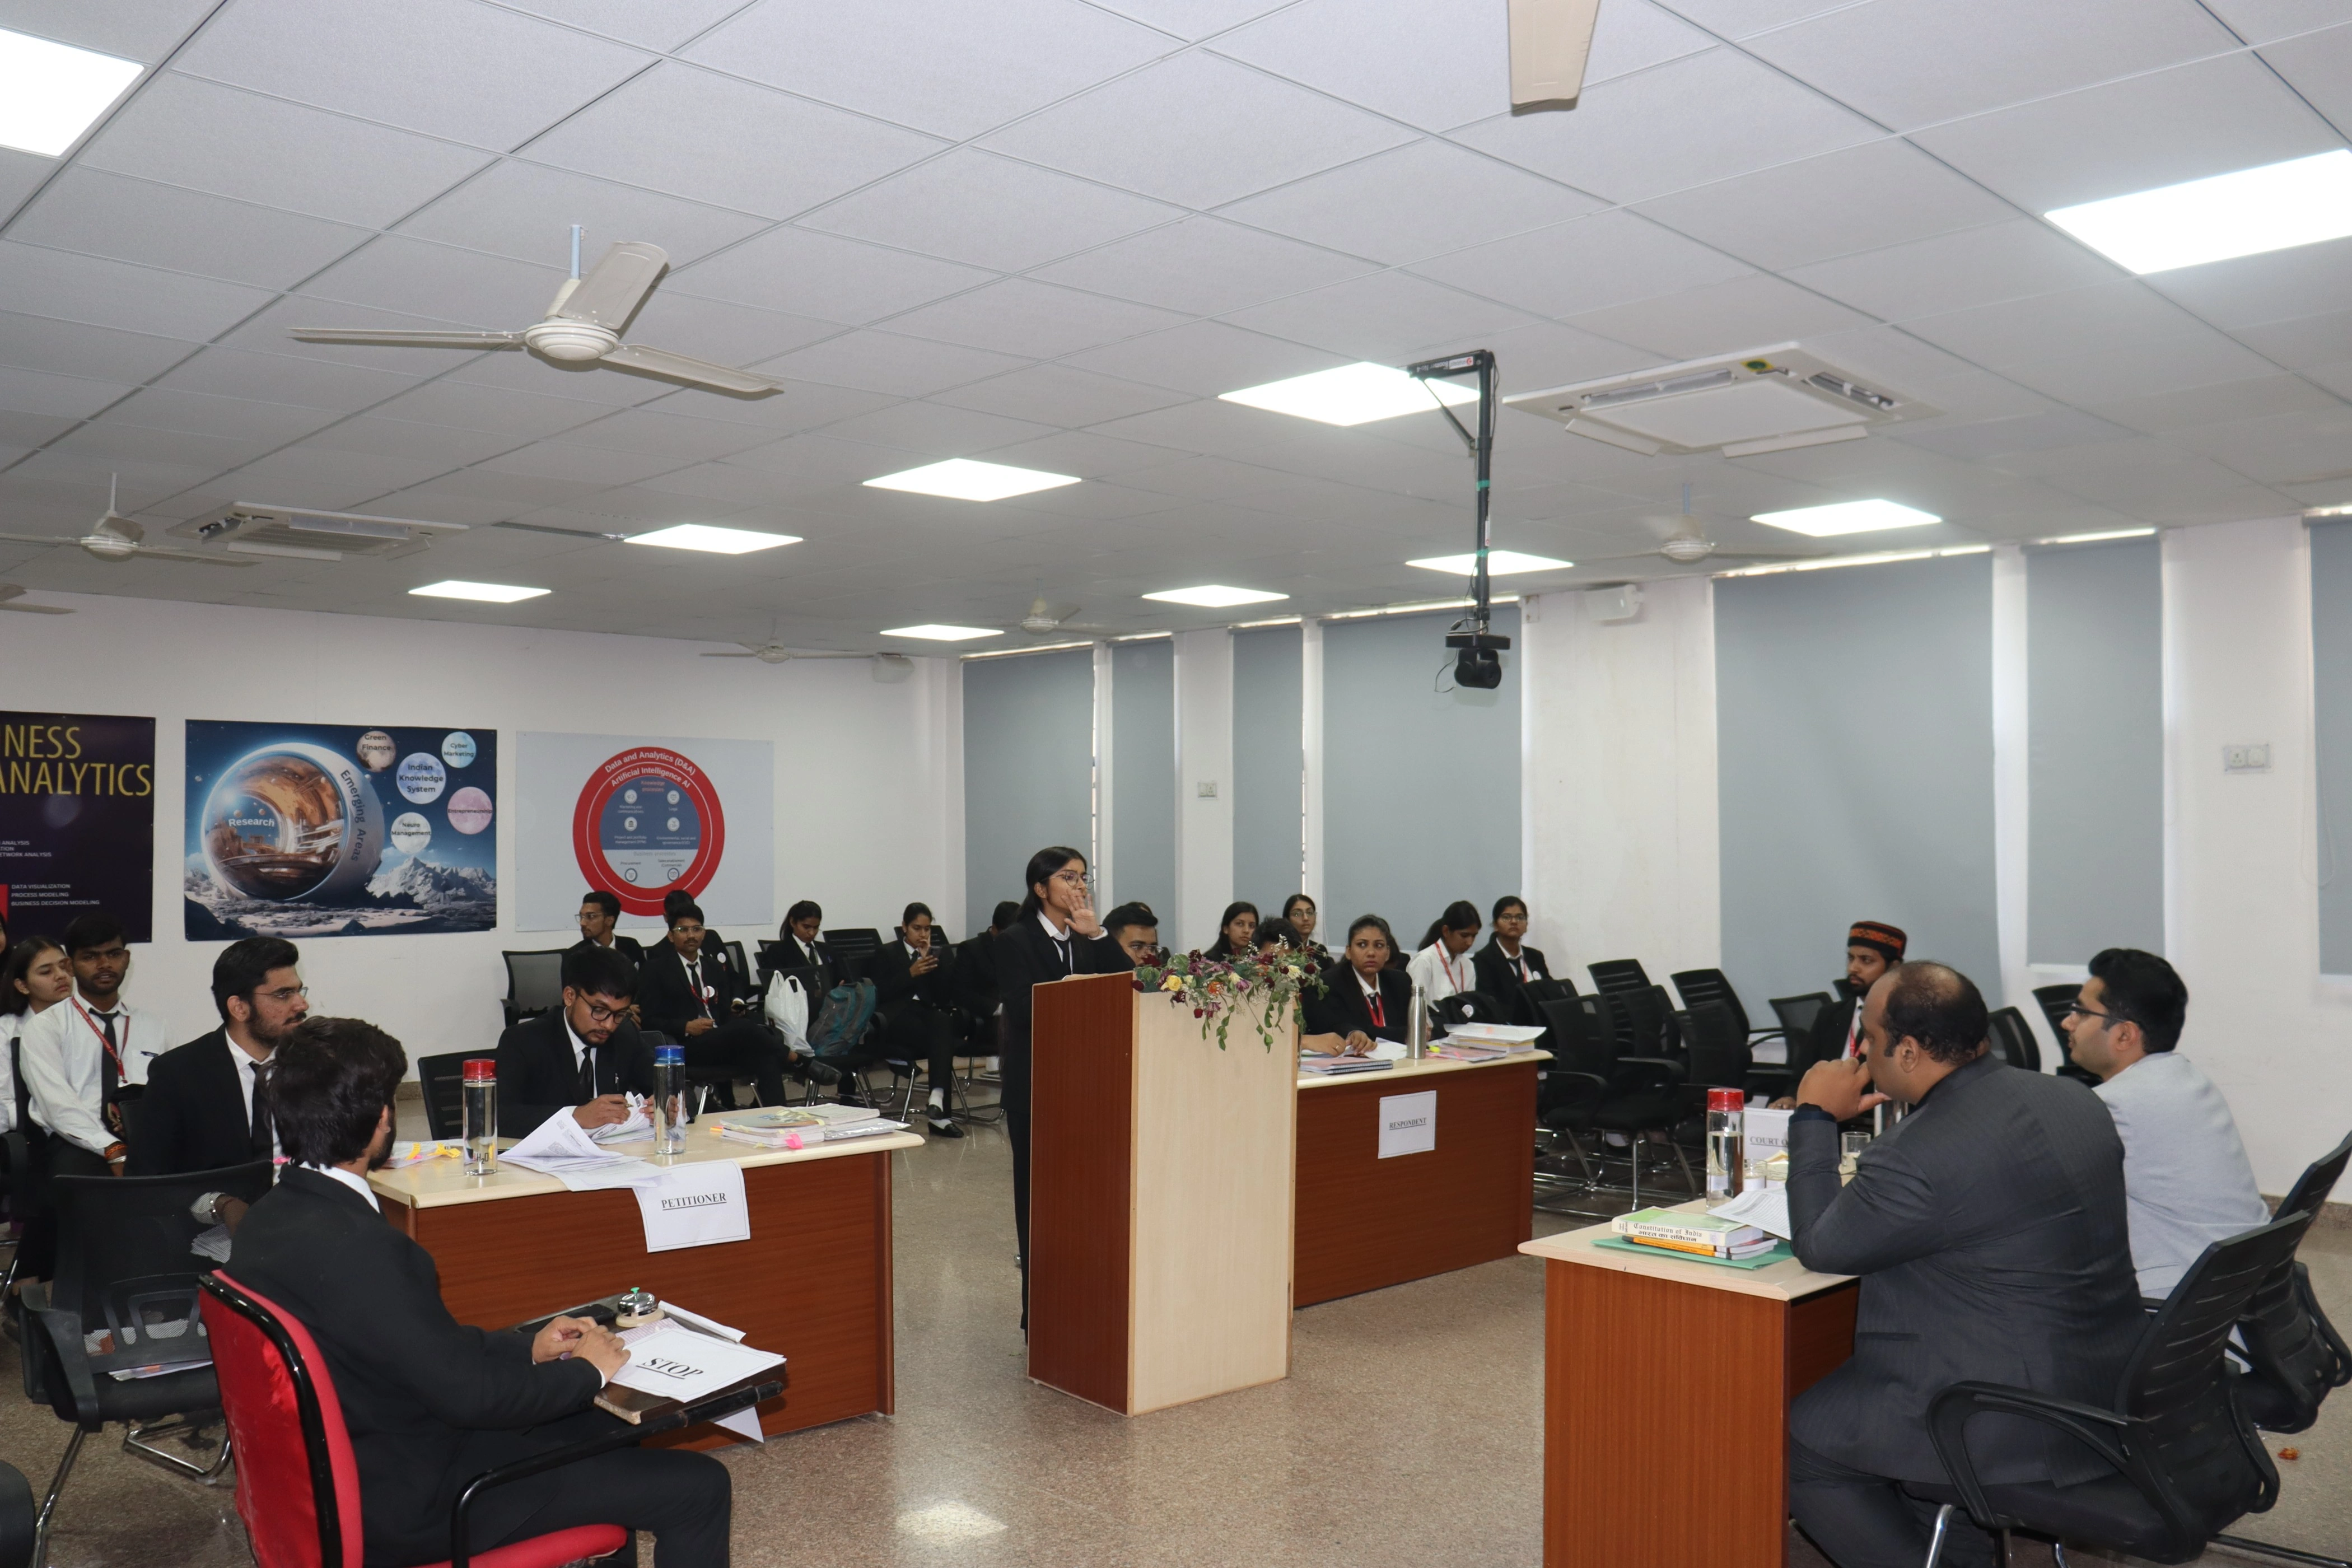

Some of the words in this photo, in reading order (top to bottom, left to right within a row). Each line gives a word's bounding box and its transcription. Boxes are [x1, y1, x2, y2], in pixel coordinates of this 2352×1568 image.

[4, 725, 81, 759] NESS
[605, 760, 623, 773] Data
[623, 753, 637, 763] and
[639, 751, 673, 762] Analytics
[674, 758, 696, 776] (D&A)
[399, 774, 444, 783] Knowledge
[611, 768, 640, 787] Artificial
[641, 767, 682, 782] Intelligence
[682, 780, 690, 788] AI
[340, 769, 366, 823] Emerging
[407, 786, 436, 794] System
[228, 818, 275, 827] Research
[351, 828, 367, 861] Areas
[1389, 1117, 1427, 1130] RESPONDENT
[1750, 1136, 1779, 1145] COURT
[661, 1192, 727, 1210] PETITIONER
[1634, 1222, 1673, 1234] Constitution
[642, 1357, 704, 1377] STOP
